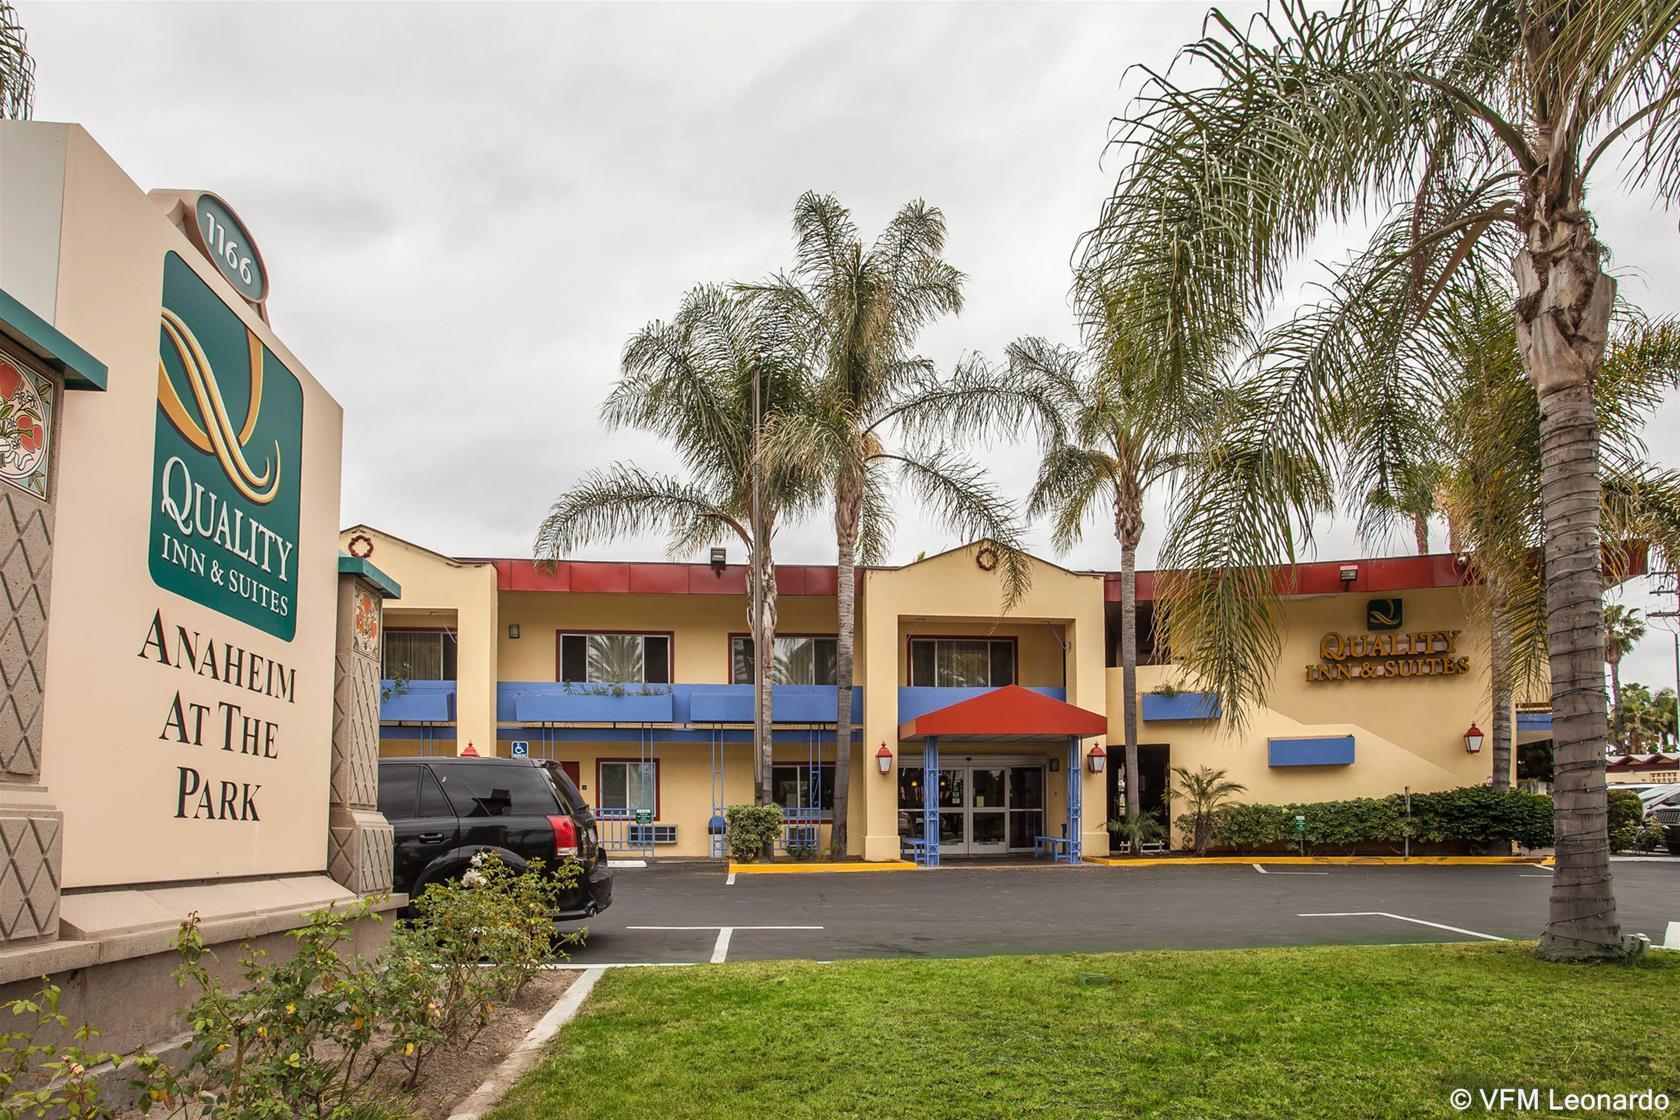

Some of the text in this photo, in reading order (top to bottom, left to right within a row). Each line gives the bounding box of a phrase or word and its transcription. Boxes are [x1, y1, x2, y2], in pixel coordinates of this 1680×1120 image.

[206, 212, 252, 285] 1166
[161, 456, 293, 582] QUALITY
[161, 533, 288, 617] INN & SUITES
[137, 607, 296, 704] ANAHEIM
[1305, 655, 1471, 682] INN & SUITES
[1319, 630, 1462, 661] QUALITY
[158, 689, 280, 760] AT THE
[173, 765, 263, 821] PARK
